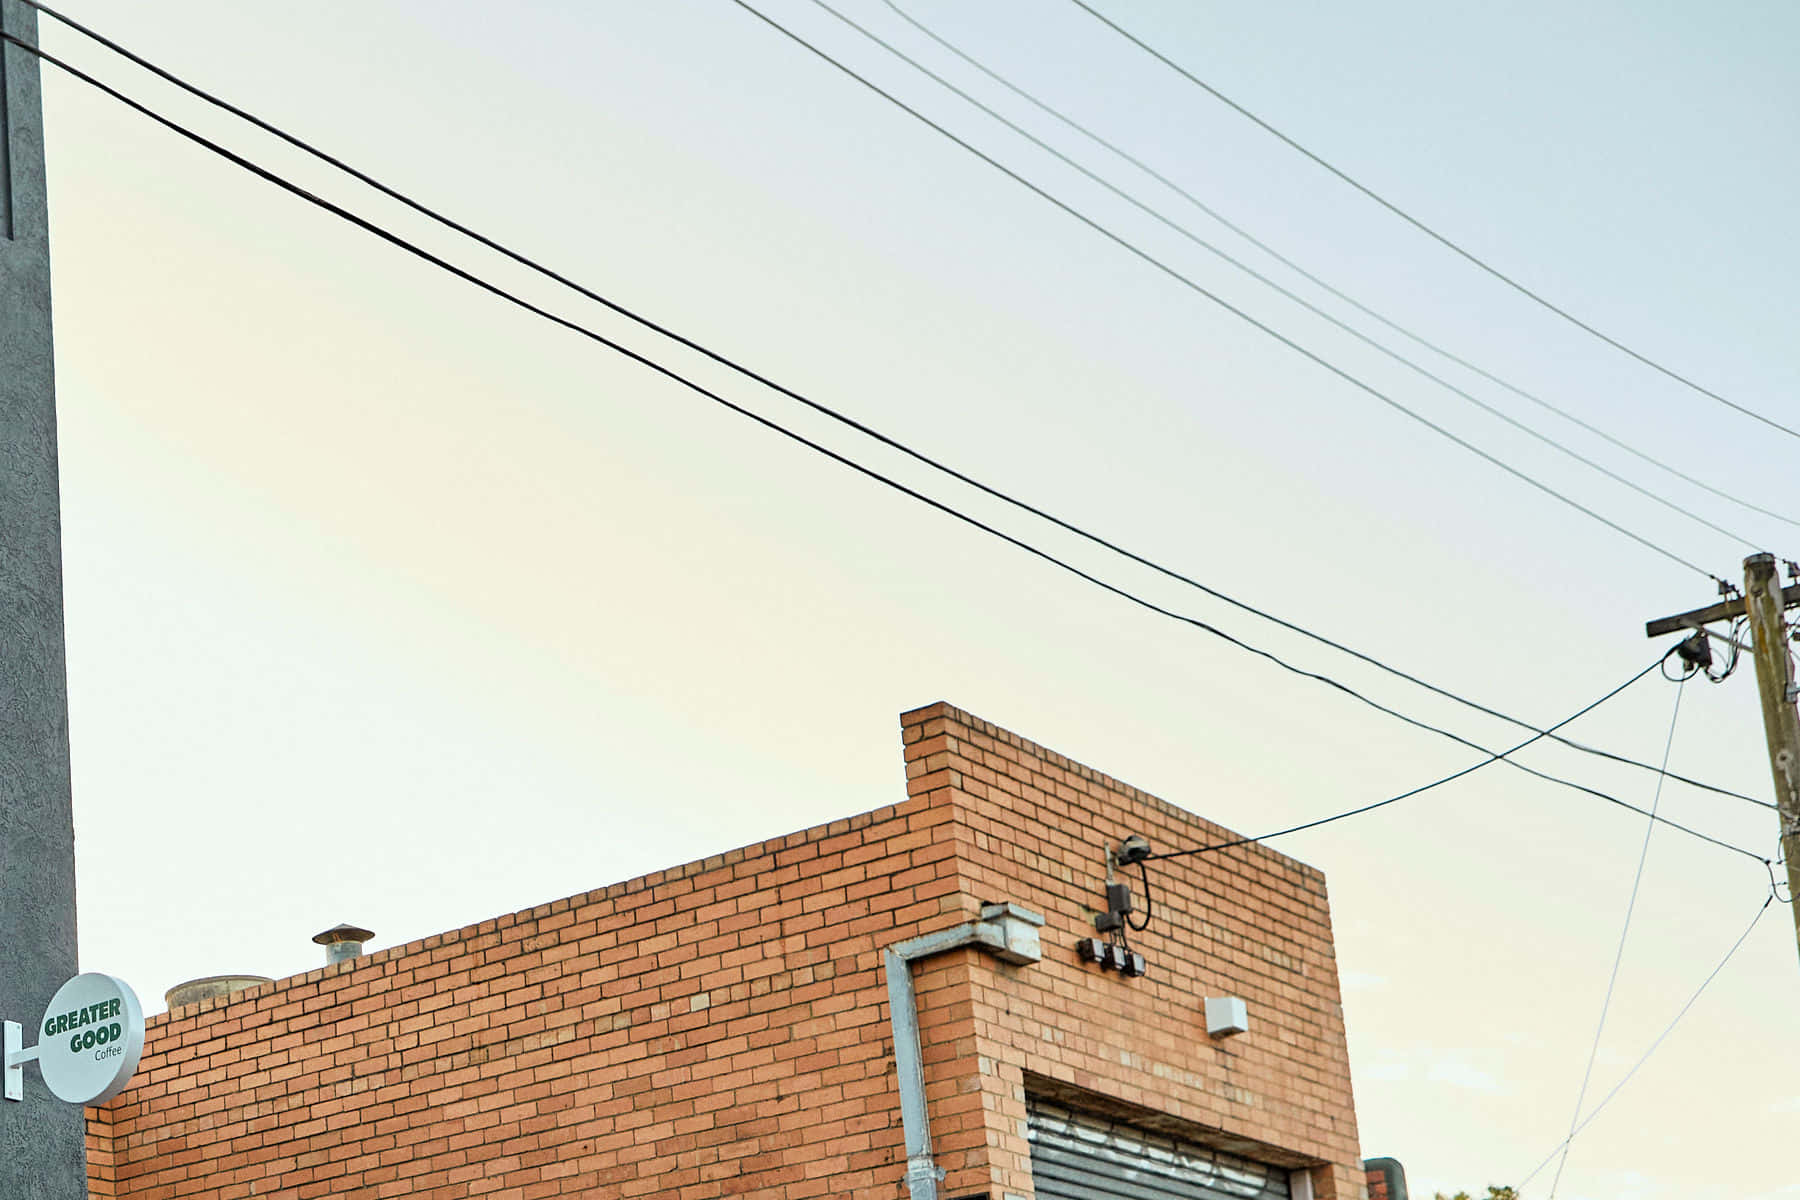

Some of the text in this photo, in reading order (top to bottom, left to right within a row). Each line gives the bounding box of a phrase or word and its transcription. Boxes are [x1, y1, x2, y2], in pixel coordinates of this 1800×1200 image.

[44, 998, 121, 1036] GREATER
[70, 1022, 122, 1053] GOOD
[95, 1046, 122, 1061] Coffee
